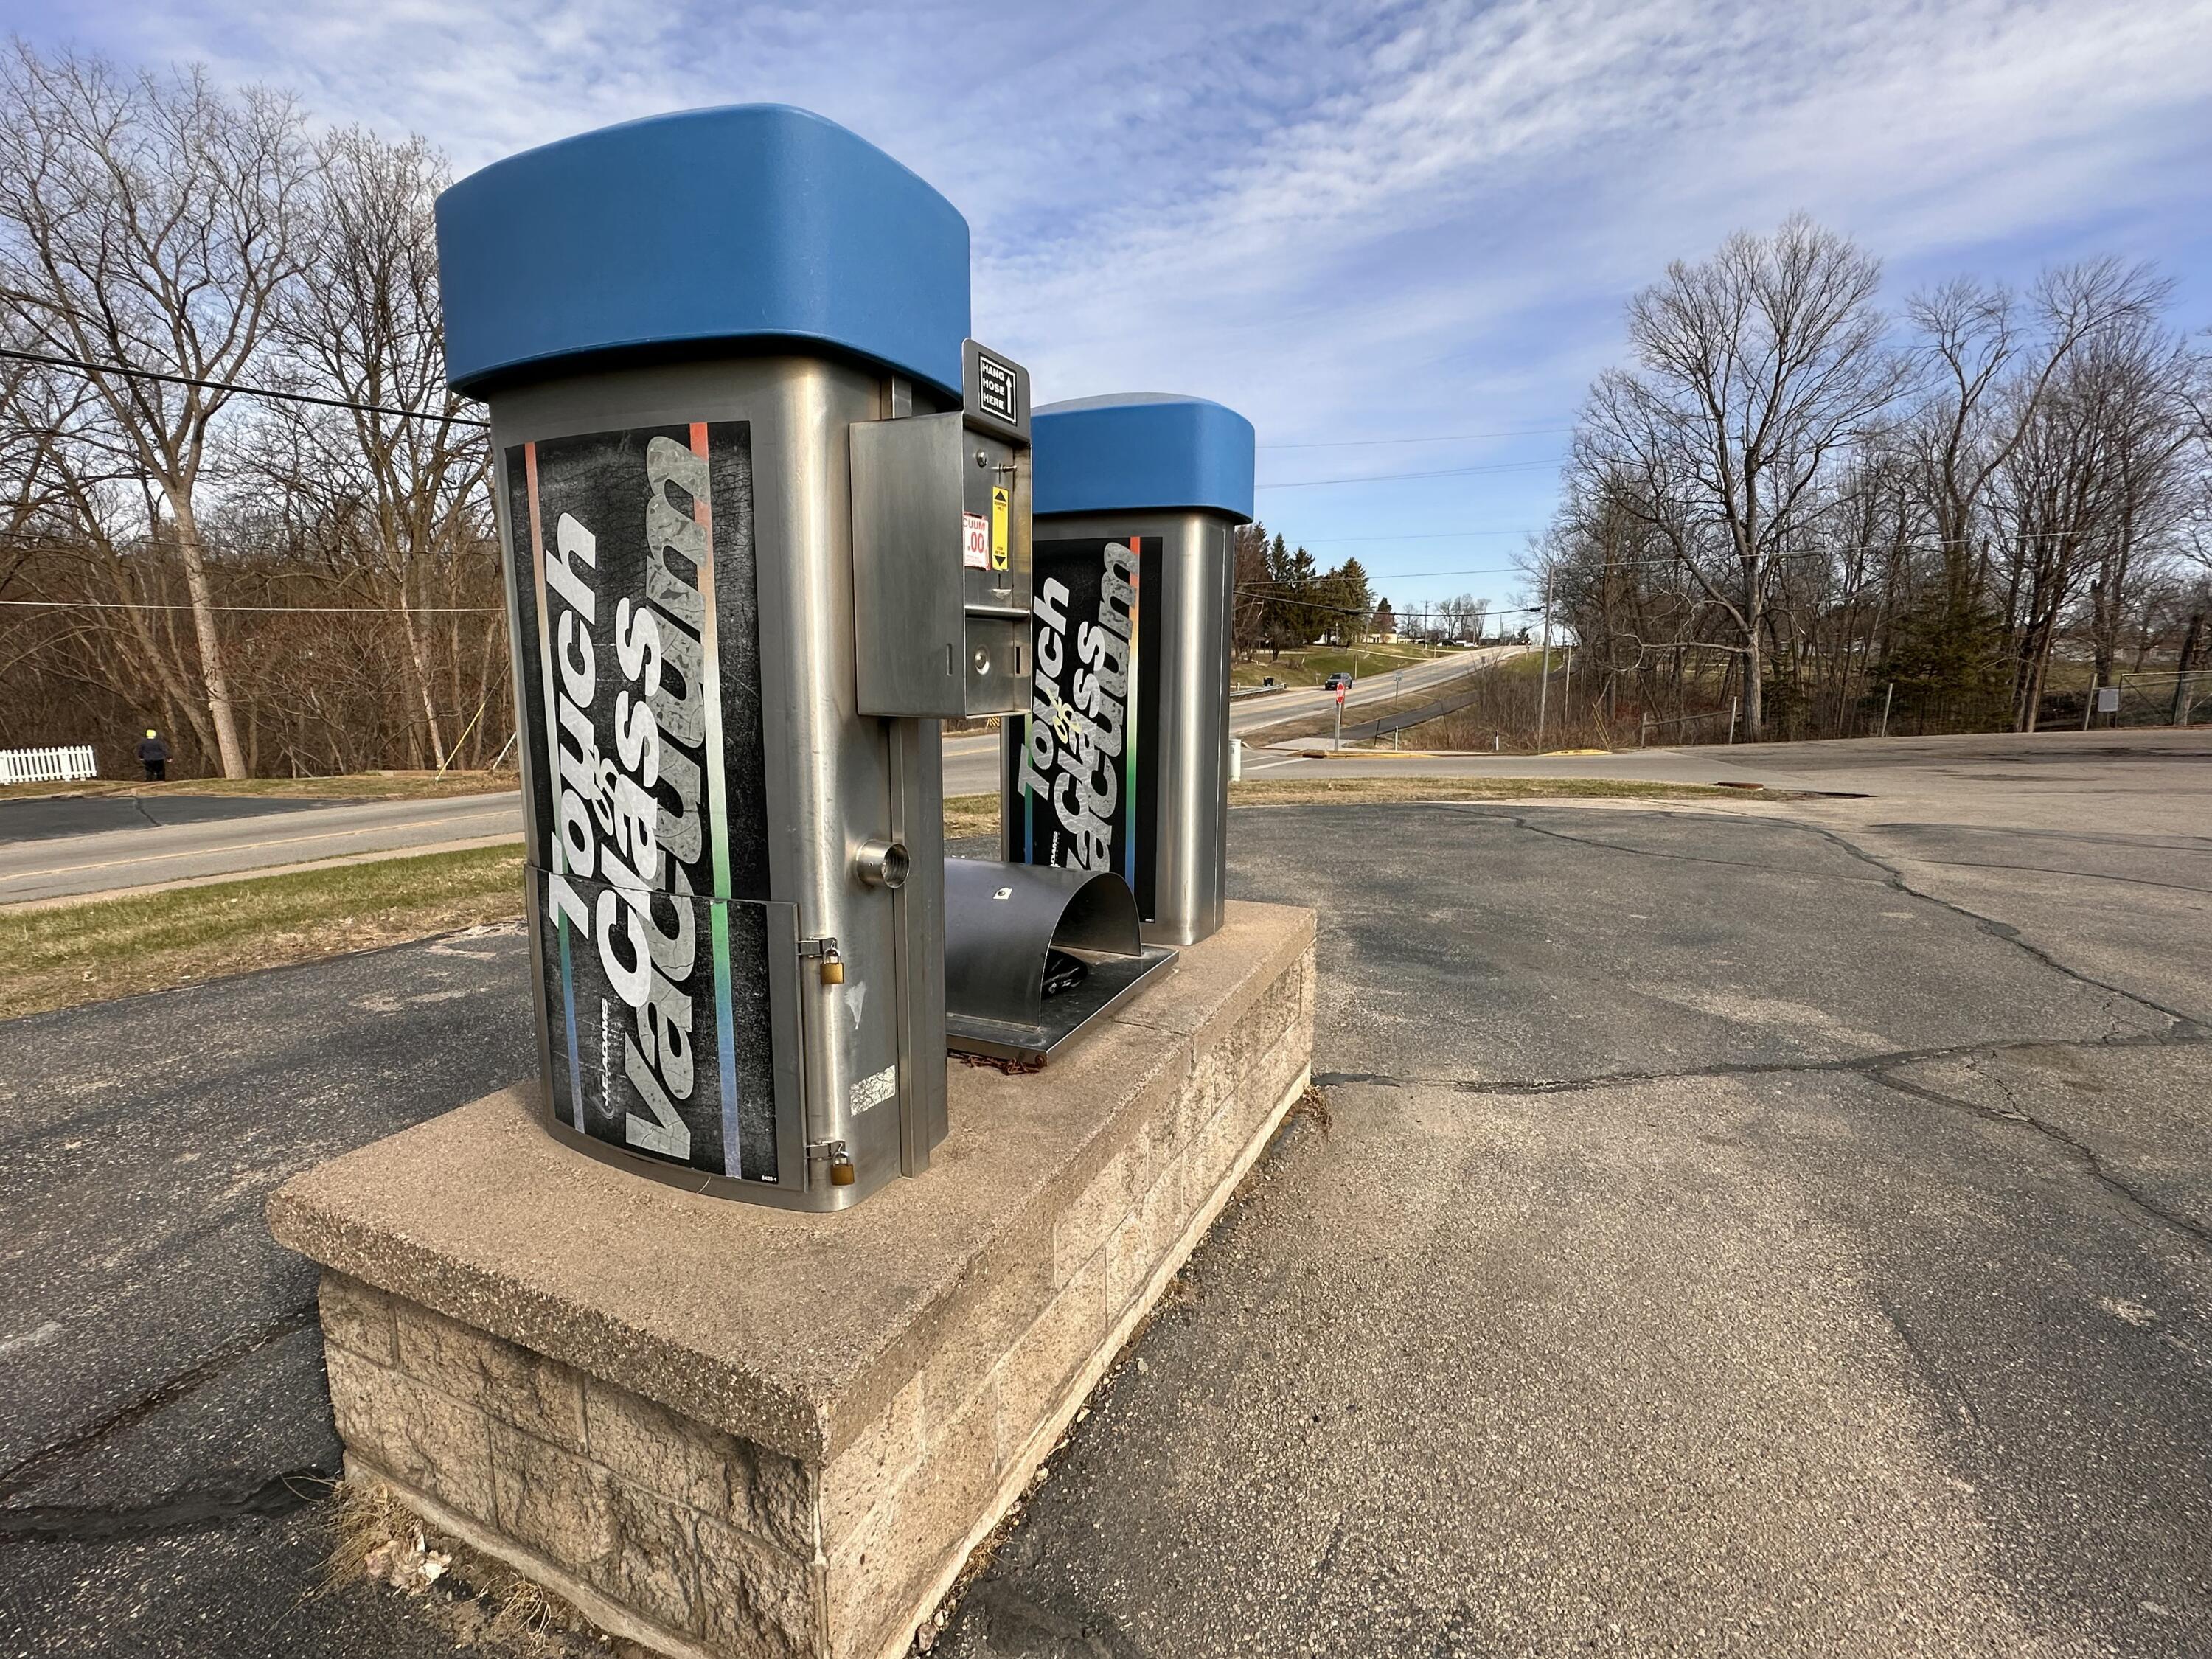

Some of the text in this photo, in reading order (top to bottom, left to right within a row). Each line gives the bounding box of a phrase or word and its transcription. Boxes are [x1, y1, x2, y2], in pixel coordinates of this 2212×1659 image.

[982, 362, 1005, 382] HANG
[983, 378, 1005, 397] HOSE
[983, 392, 1004, 410] HERE
[964, 531, 984, 554] .00
[1018, 577, 1105, 835] Touch of Class
[546, 512, 662, 1007] Touch of Class
[625, 436, 709, 1160] Vacuum
